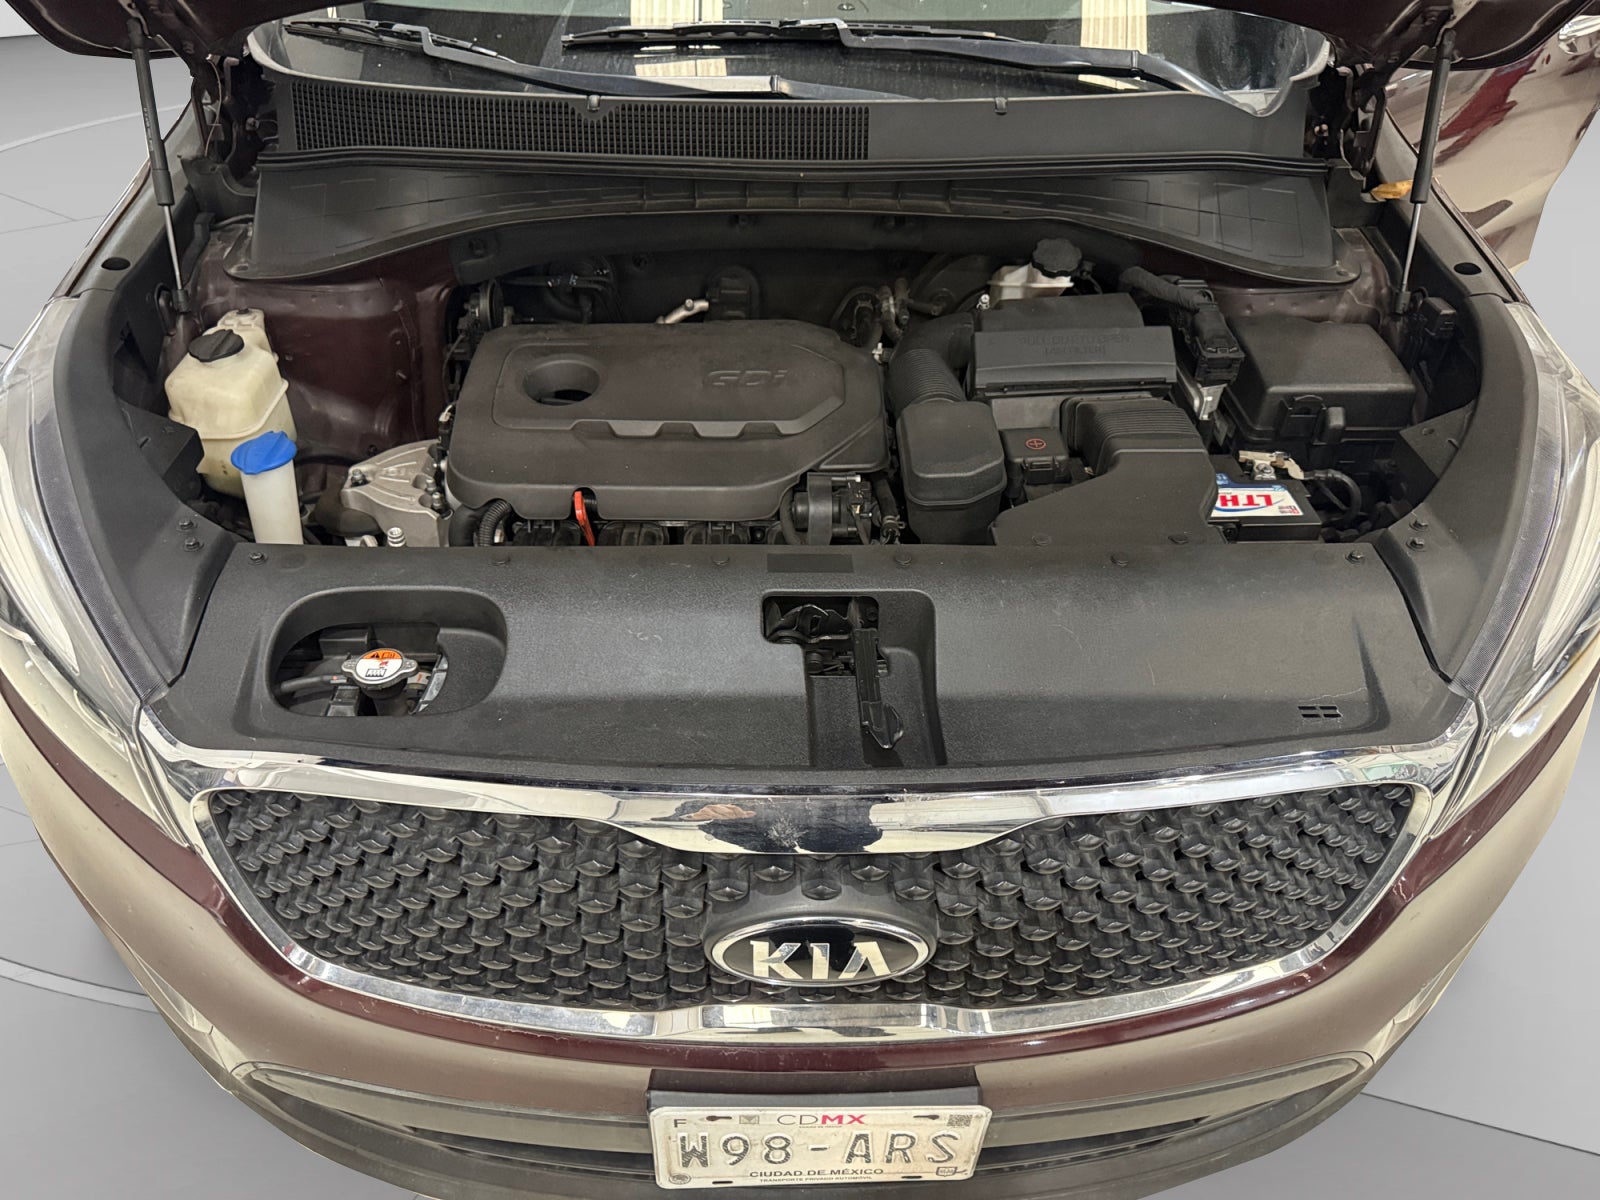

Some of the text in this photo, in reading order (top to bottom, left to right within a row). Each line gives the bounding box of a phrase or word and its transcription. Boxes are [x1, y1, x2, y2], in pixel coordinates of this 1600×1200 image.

[1219, 494, 1273, 507] LTH
[750, 940, 892, 980] KIA
[673, 1114, 866, 1128] F CDMX
[749, 1170, 803, 1178] CIUDAD
[830, 1168, 884, 1176] MÉXICO
